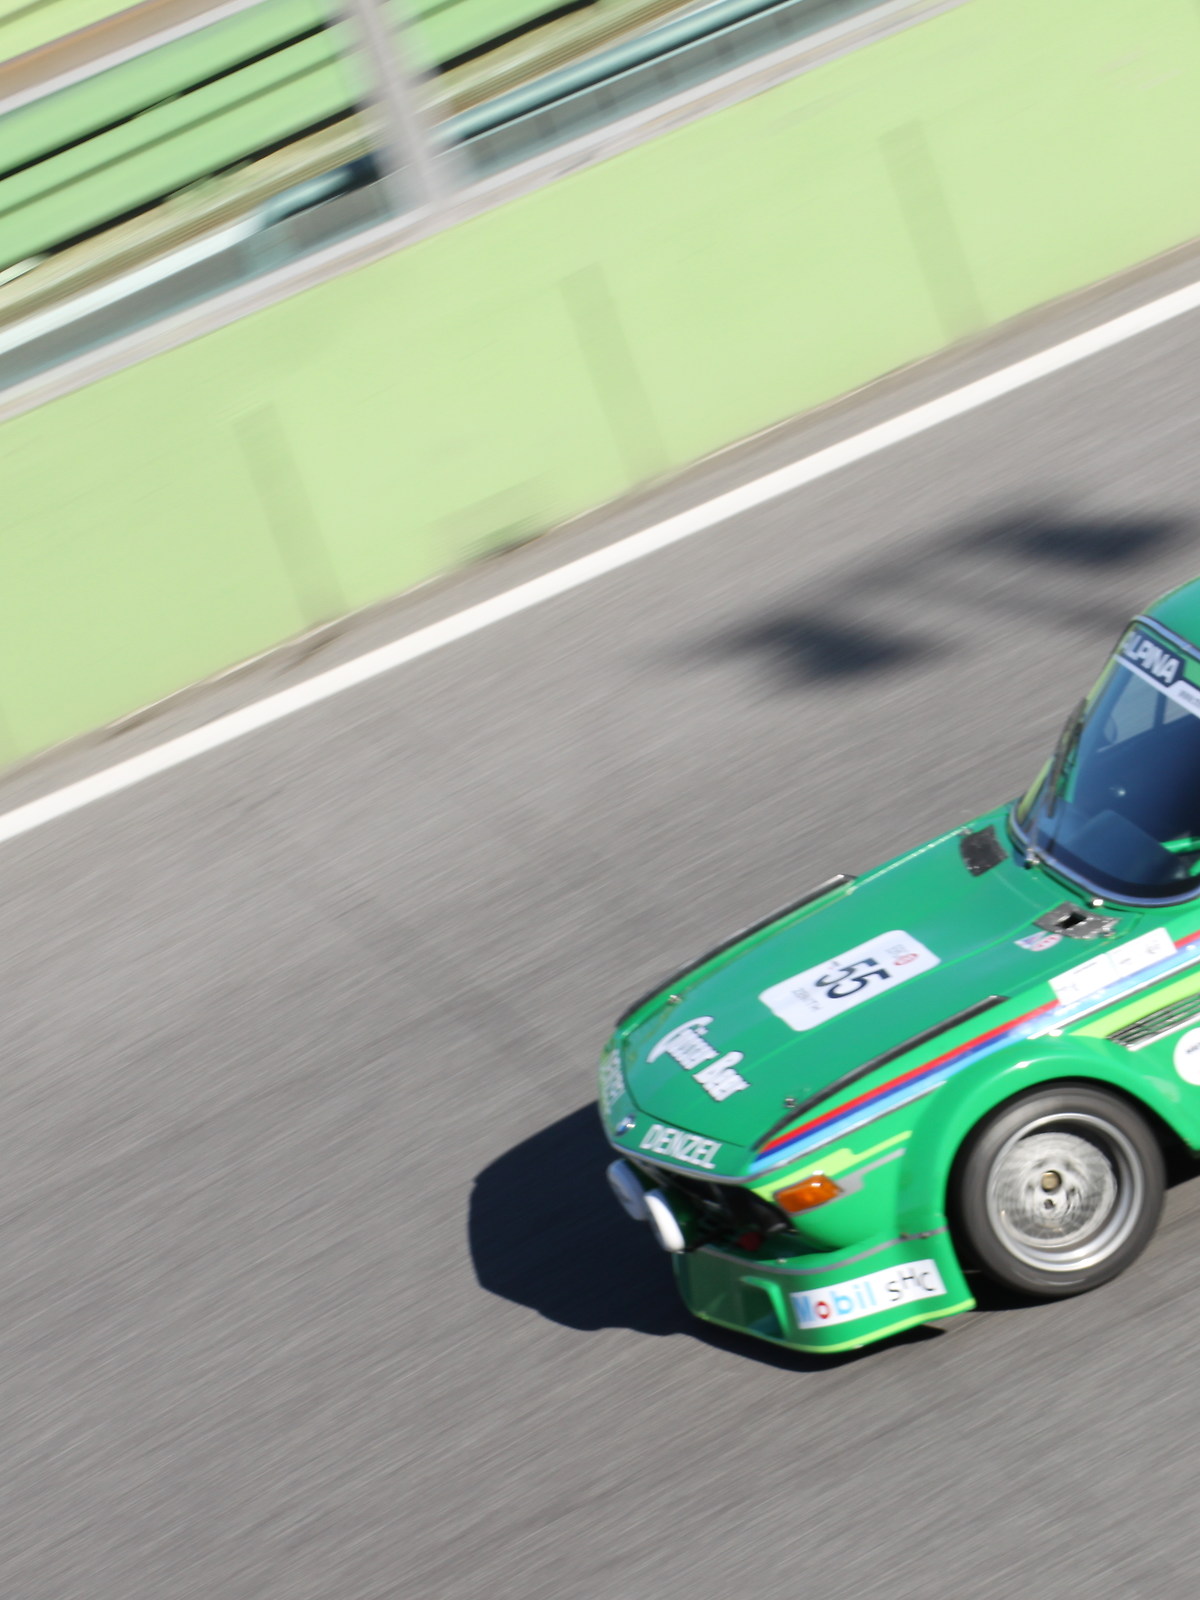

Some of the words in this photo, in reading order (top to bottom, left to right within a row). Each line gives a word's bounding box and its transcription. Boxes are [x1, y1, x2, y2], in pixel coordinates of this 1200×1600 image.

[1121, 631, 1181, 684] ALPINA
[814, 957, 891, 999] 55
[639, 1123, 723, 1169] DENZEL
[792, 1281, 878, 1323] Mobil
[885, 1268, 937, 1302] SHC
